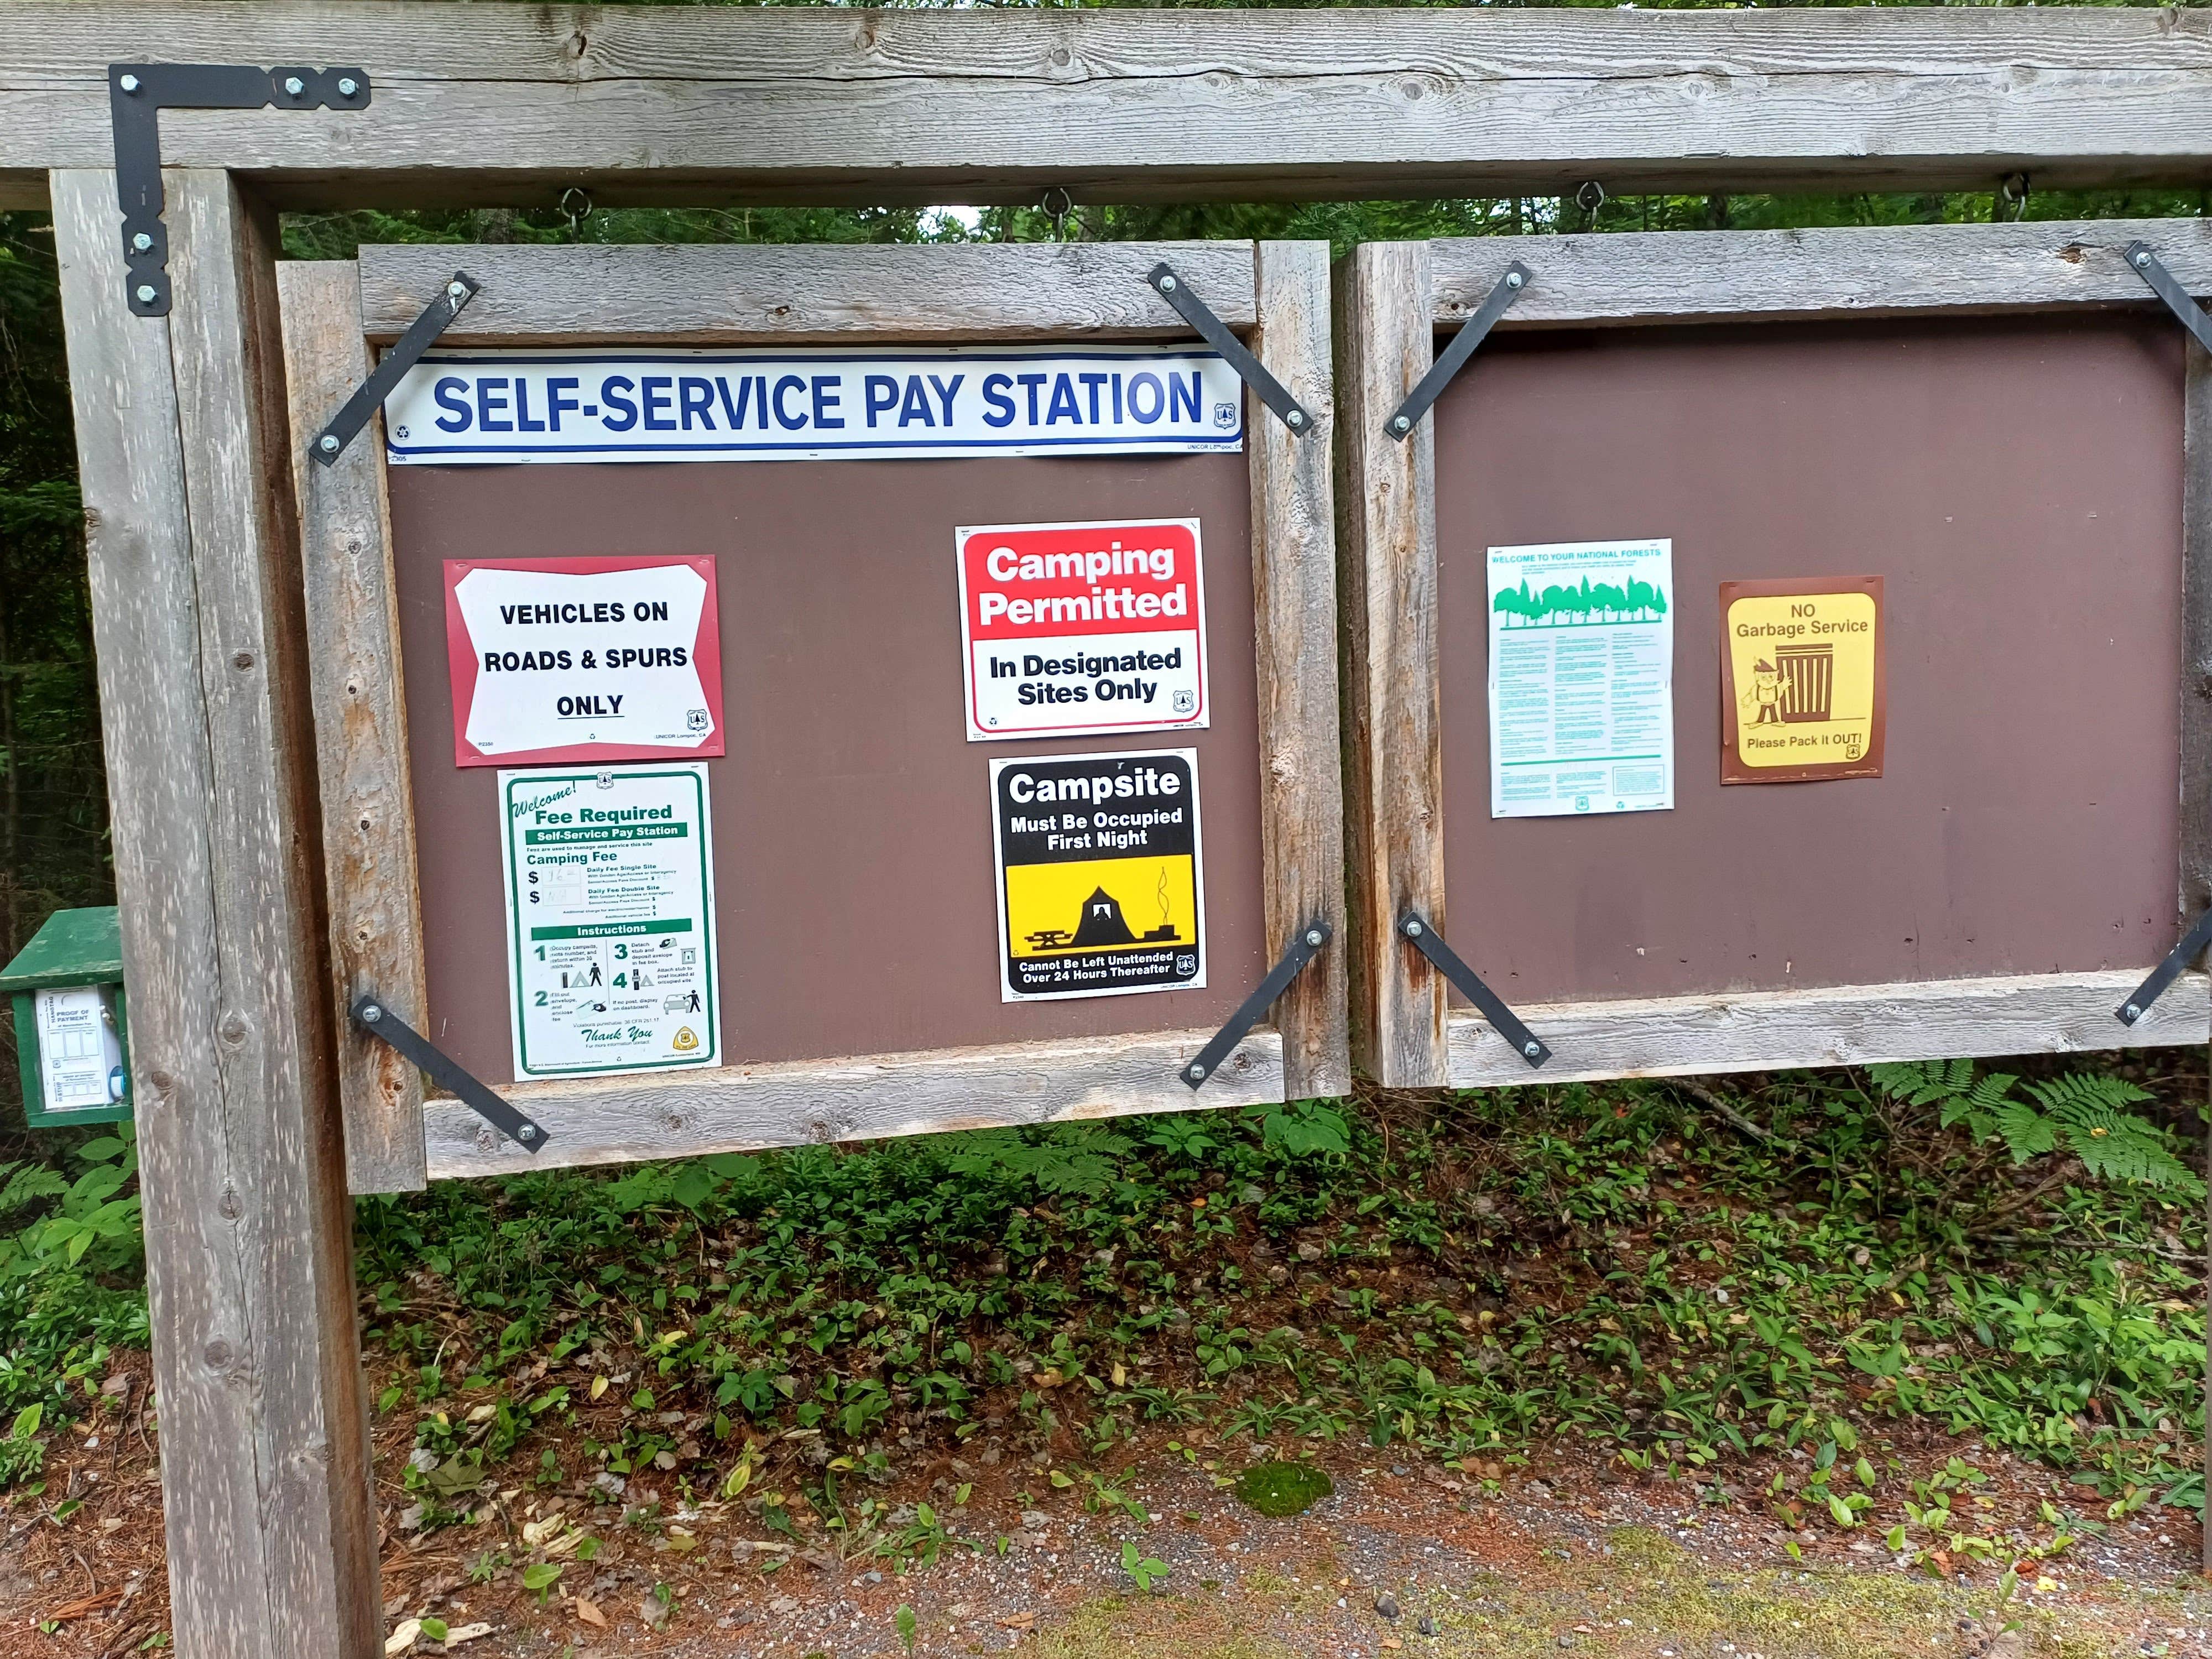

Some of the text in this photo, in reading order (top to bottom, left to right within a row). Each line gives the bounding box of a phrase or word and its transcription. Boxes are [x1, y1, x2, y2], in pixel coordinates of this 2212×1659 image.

[434, 372, 1201, 432] SELF-SERVICE PAY STATION
[987, 541, 1175, 584] Camping
[1491, 555, 1536, 563] WELCOME
[1577, 551, 1619, 559] NATIONAL
[1621, 549, 1661, 557] FORESTS
[500, 602, 668, 624] VEHICLES ON
[979, 583, 1187, 625] Permitted
[1791, 603, 1815, 618] NO
[1736, 619, 1867, 638] Garbage Service
[485, 647, 687, 672] ROADS & SPURS
[990, 648, 1181, 677] In Designated
[1018, 678, 1157, 705] Sites Only
[557, 695, 624, 716] ONLY
[1747, 733, 1861, 748] Please Pack it OUT!
[1009, 767, 1181, 805] Campsite
[513, 780, 577, 818] Welcome!
[536, 805, 672, 825] Fee Required
[1011, 808, 1183, 833] Must Be Occupied
[538, 826, 678, 841] Self-Service Pay Station
[1047, 830, 1147, 850] First Night
[527, 851, 617, 865] Camping Fee
[529, 870, 539, 885] $
[530, 890, 540, 905] $
[577, 925, 646, 936] Instructions
[534, 945, 546, 961] 1
[614, 943, 628, 959] 3
[1019, 951, 1173, 972] Cannot Be Left Unattended
[613, 972, 628, 988] 4
[1023, 964, 1170, 984] Over 24 Hours Thereafter
[534, 990, 549, 1006] 2
[581, 1026, 653, 1042] Thank You
